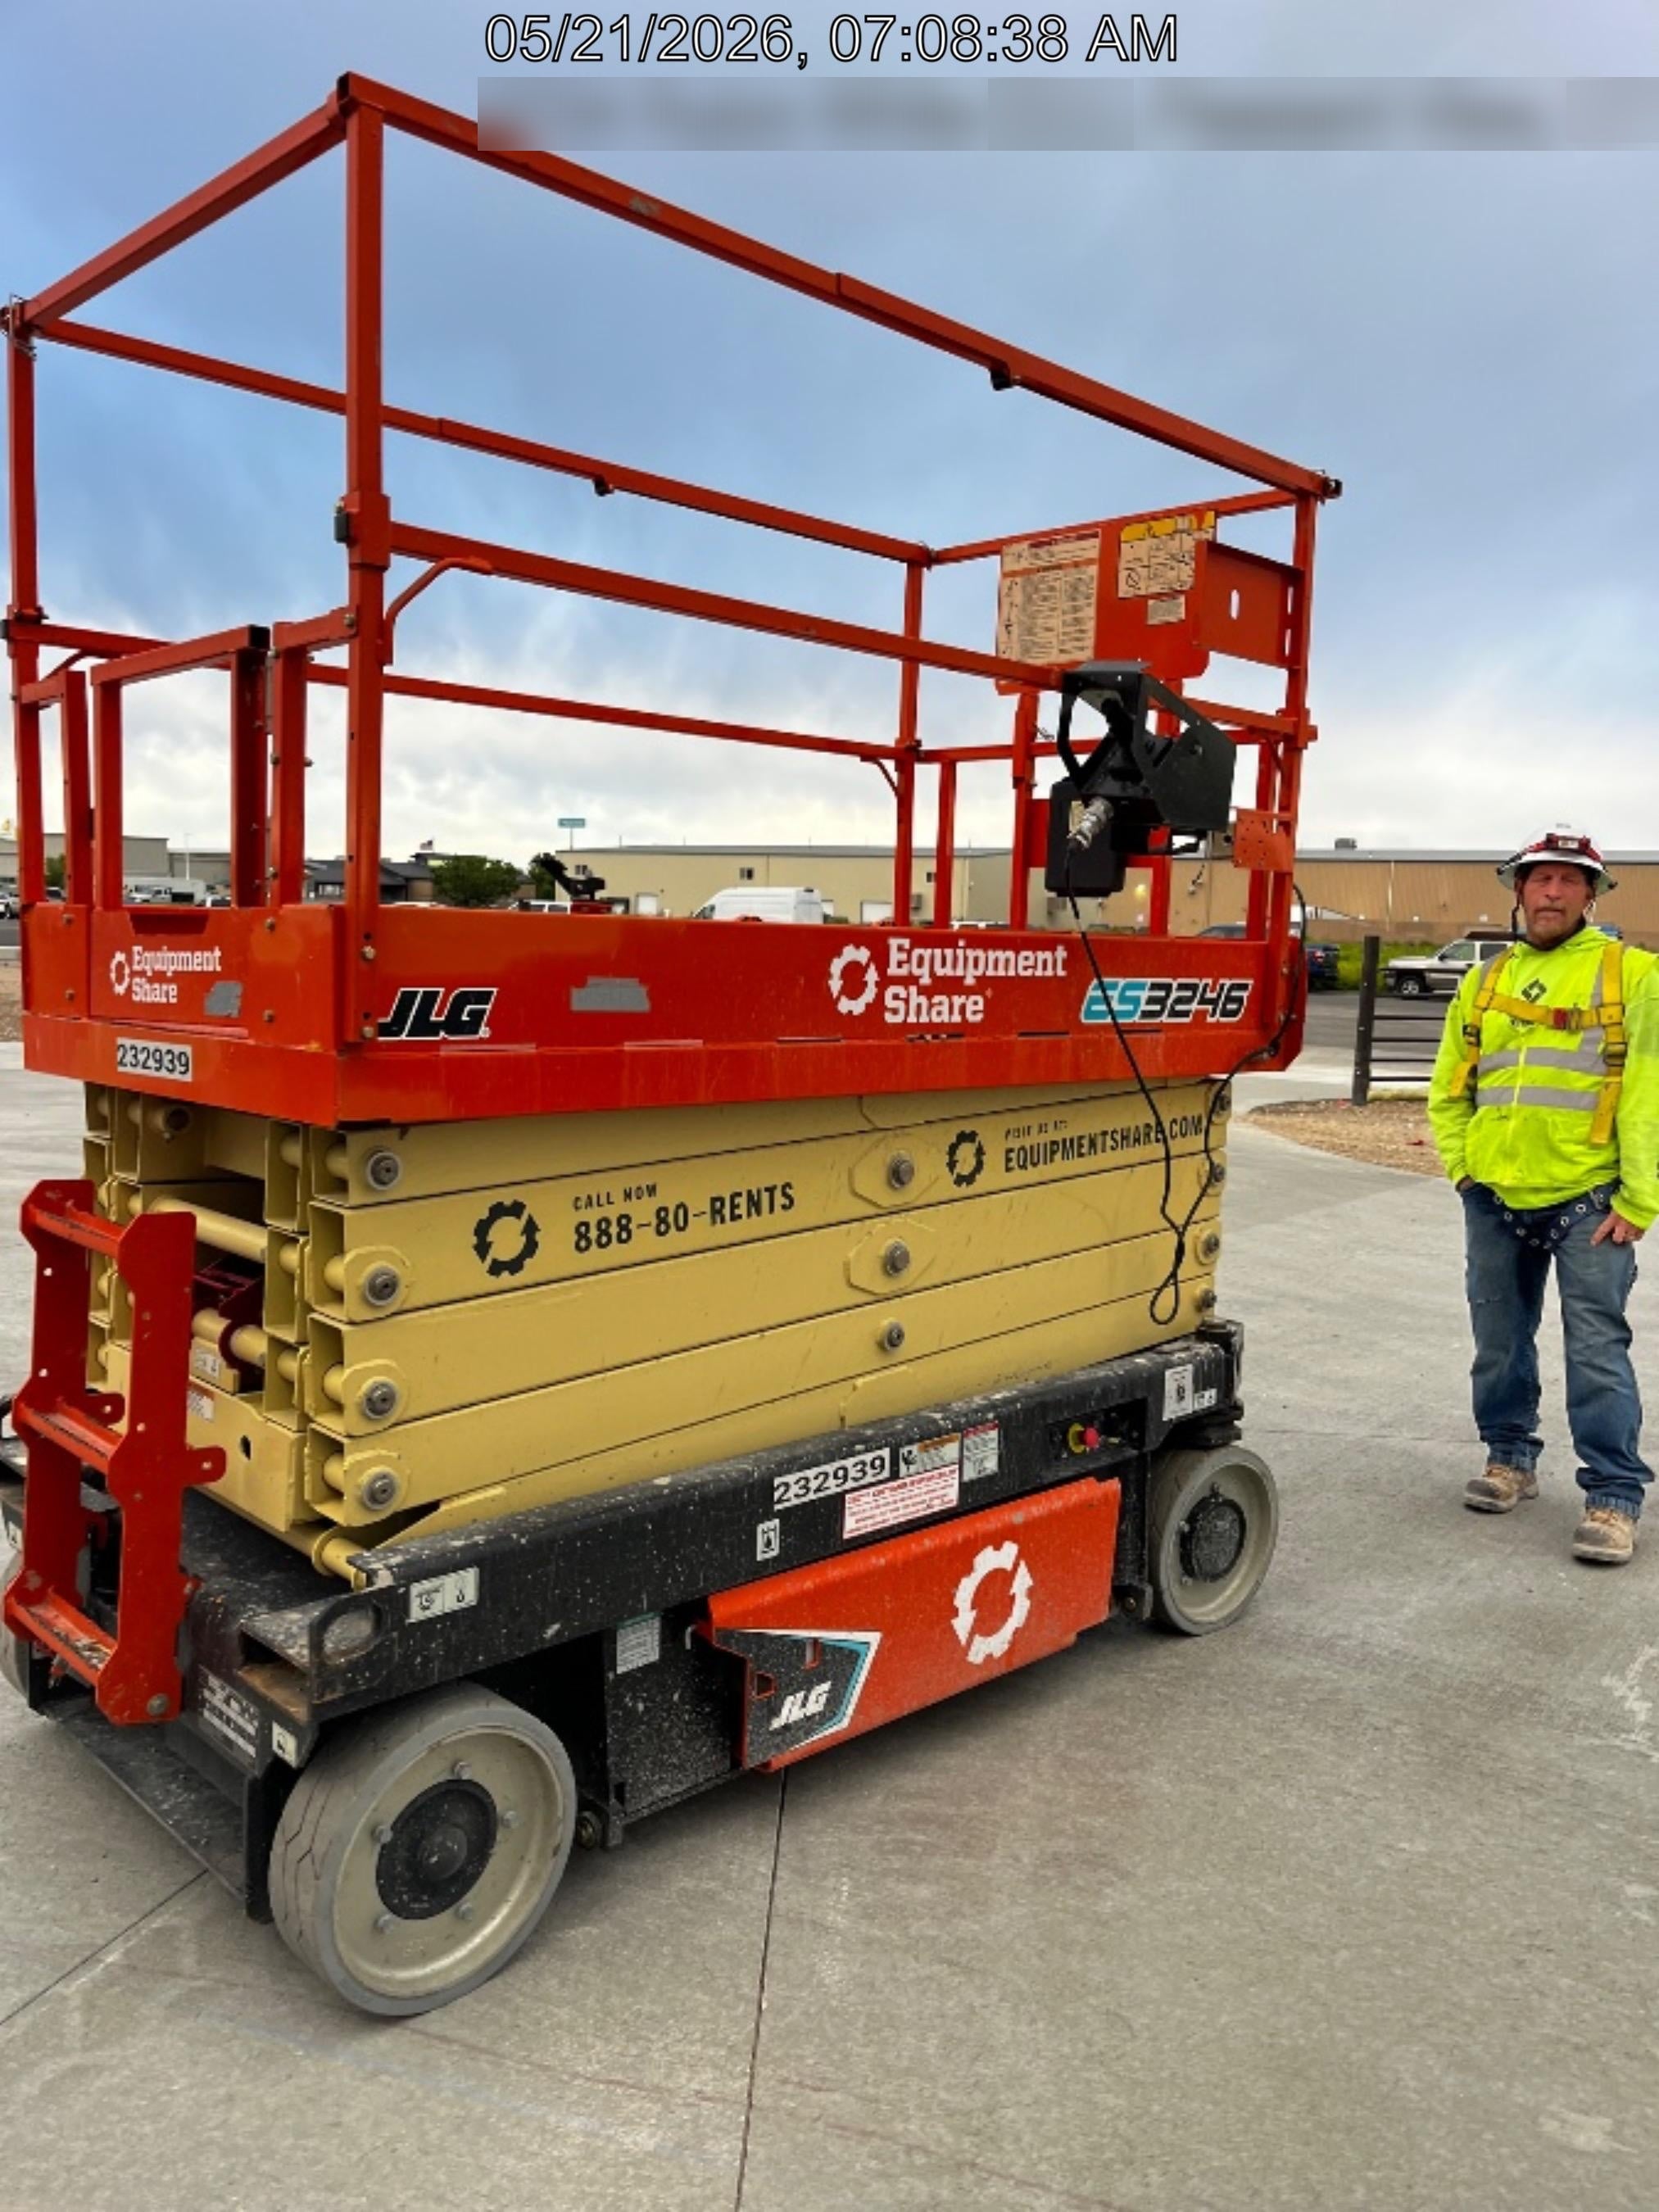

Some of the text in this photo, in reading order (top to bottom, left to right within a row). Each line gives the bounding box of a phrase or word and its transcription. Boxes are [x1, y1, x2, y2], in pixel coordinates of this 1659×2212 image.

[132, 945, 222, 977] Equipment
[886, 937, 1067, 986] Equipment
[132, 977, 178, 1004] Share
[378, 987, 498, 1040] JLG
[884, 985, 984, 1023] Share
[1081, 977, 1254, 1023] ES3246
[117, 1044, 190, 1075] 232939
[1004, 1113, 1203, 1173] EQUIPMENTSHARECOM
[574, 1183, 658, 1211] CALL NOW
[574, 1181, 796, 1254] 888-80-RENTS
[774, 1454, 886, 1503] 232939
[768, 1680, 832, 1731] JLG
